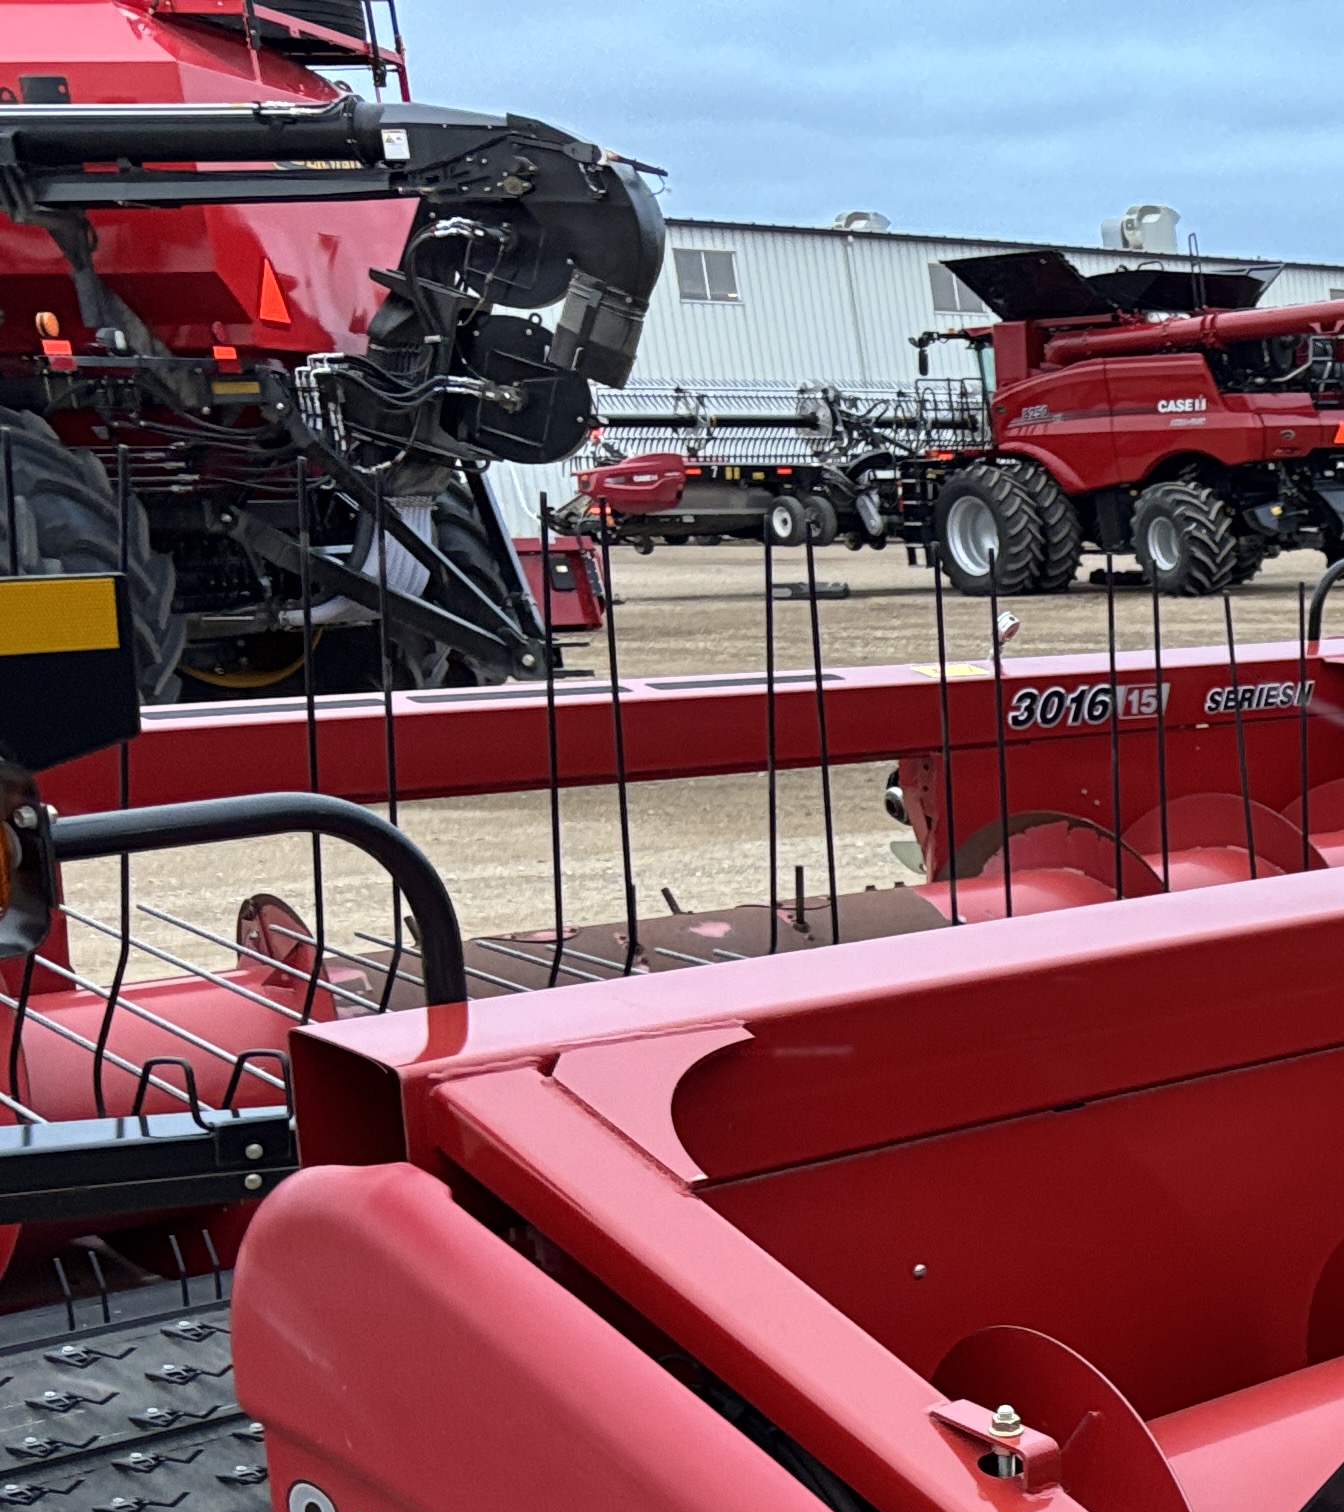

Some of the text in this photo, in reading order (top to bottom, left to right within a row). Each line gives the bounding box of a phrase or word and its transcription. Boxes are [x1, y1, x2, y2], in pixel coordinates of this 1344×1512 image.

[1157, 399, 1193, 413] CASE
[710, 465, 719, 479] 7
[1007, 684, 1111, 730] 3016
[1128, 689, 1158, 715] 15
[1203, 682, 1295, 714] SERIES
